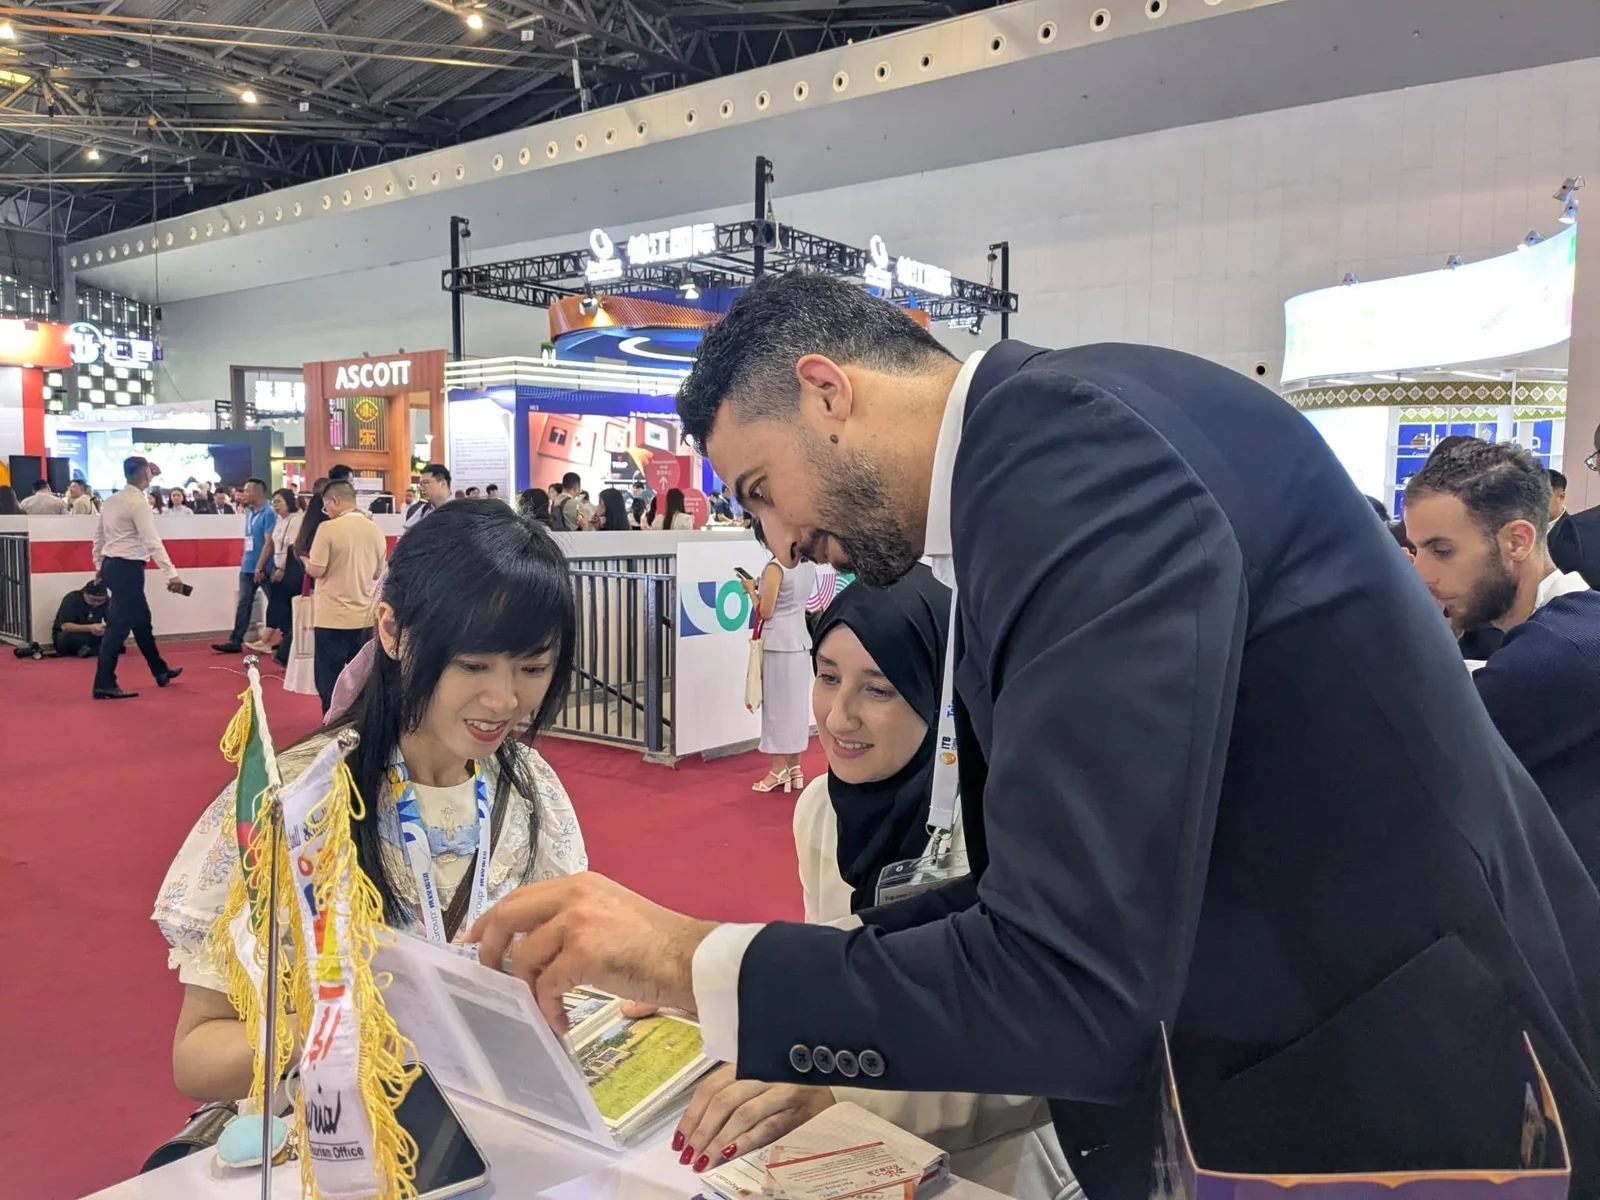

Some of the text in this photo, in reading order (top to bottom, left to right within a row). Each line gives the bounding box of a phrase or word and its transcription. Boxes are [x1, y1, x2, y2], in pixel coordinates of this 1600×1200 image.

[335, 360, 412, 390] ASCOTT
[941, 736, 951, 750] ITB
[332, 1146, 364, 1159] Office
